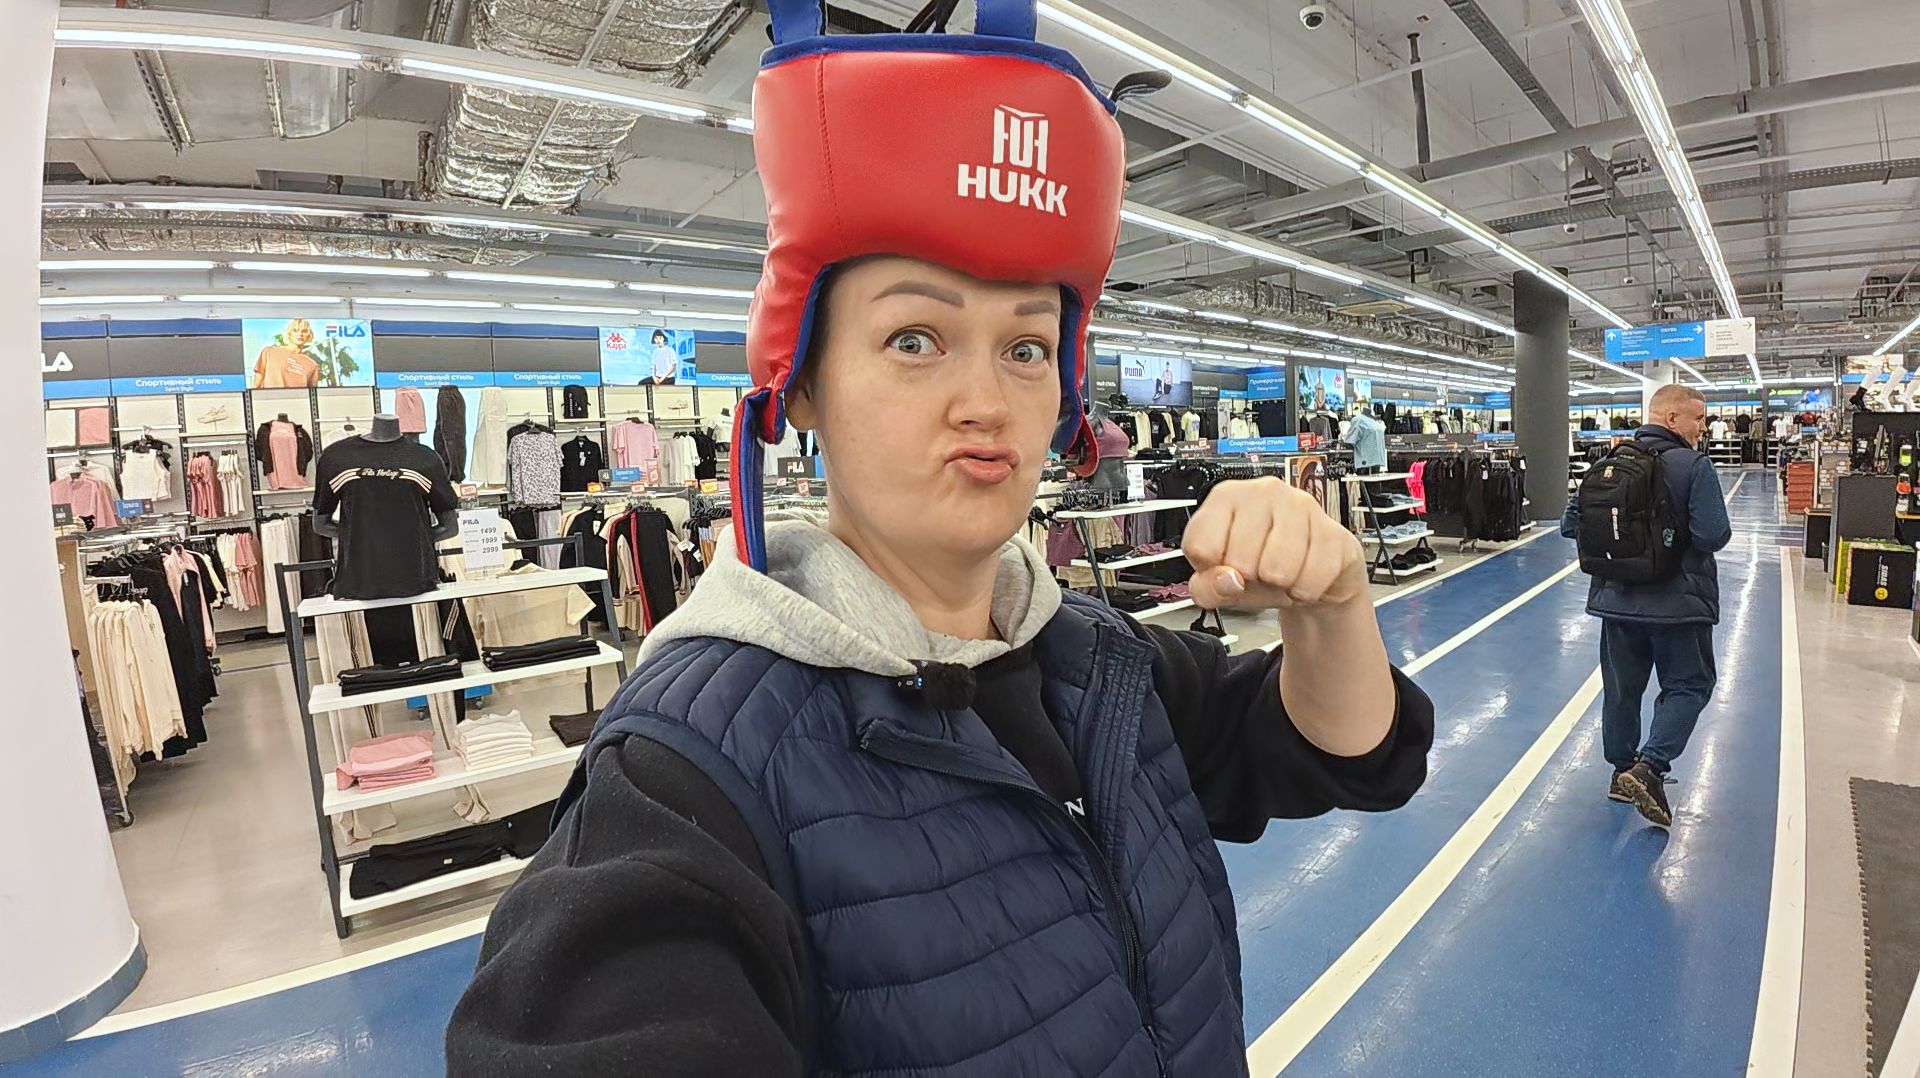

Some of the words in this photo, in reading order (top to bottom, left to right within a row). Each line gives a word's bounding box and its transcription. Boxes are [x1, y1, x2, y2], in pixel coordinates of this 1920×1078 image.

[957, 163, 1068, 217] HUKK
[326, 325, 366, 338] FILA
[606, 341, 627, 351] Kappa
[1124, 367, 1143, 378] PUMA
[398, 373, 450, 382] Спортивный
[450, 373, 475, 381] стиль
[513, 373, 561, 382] Спортивный
[135, 377, 194, 388] Спортивный
[195, 377, 222, 385] стиль
[787, 461, 805, 473] FILA
[462, 518, 480, 526] FILA
[480, 527, 497, 535] 1499
[481, 536, 498, 544] 1999
[482, 546, 499, 554] 2999
